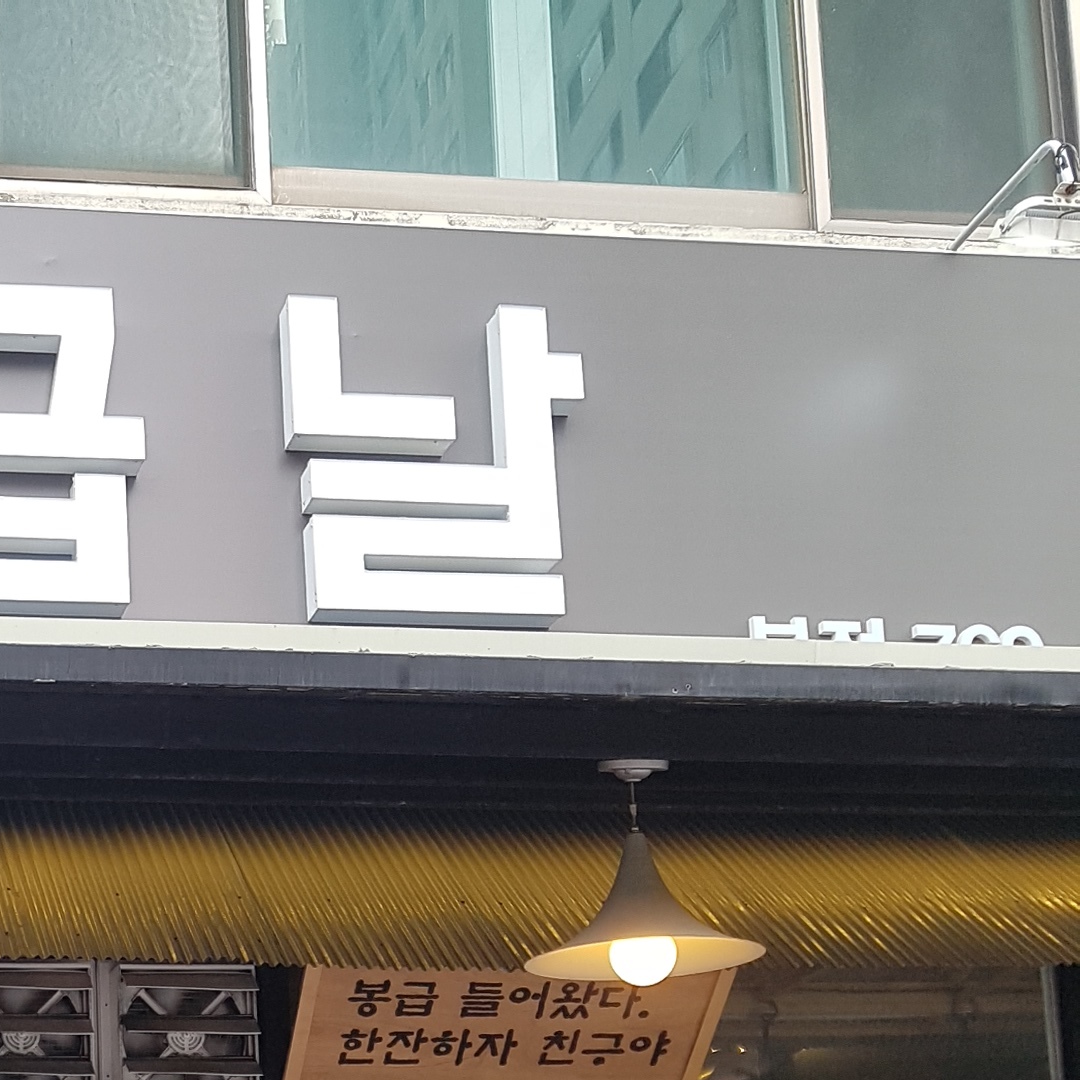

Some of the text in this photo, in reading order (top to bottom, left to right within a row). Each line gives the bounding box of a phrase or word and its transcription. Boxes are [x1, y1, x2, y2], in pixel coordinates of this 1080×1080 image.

[347, 979, 651, 1020] 봉급 들어왔다.
[337, 1027, 673, 1066] 한잔하자 친구야
